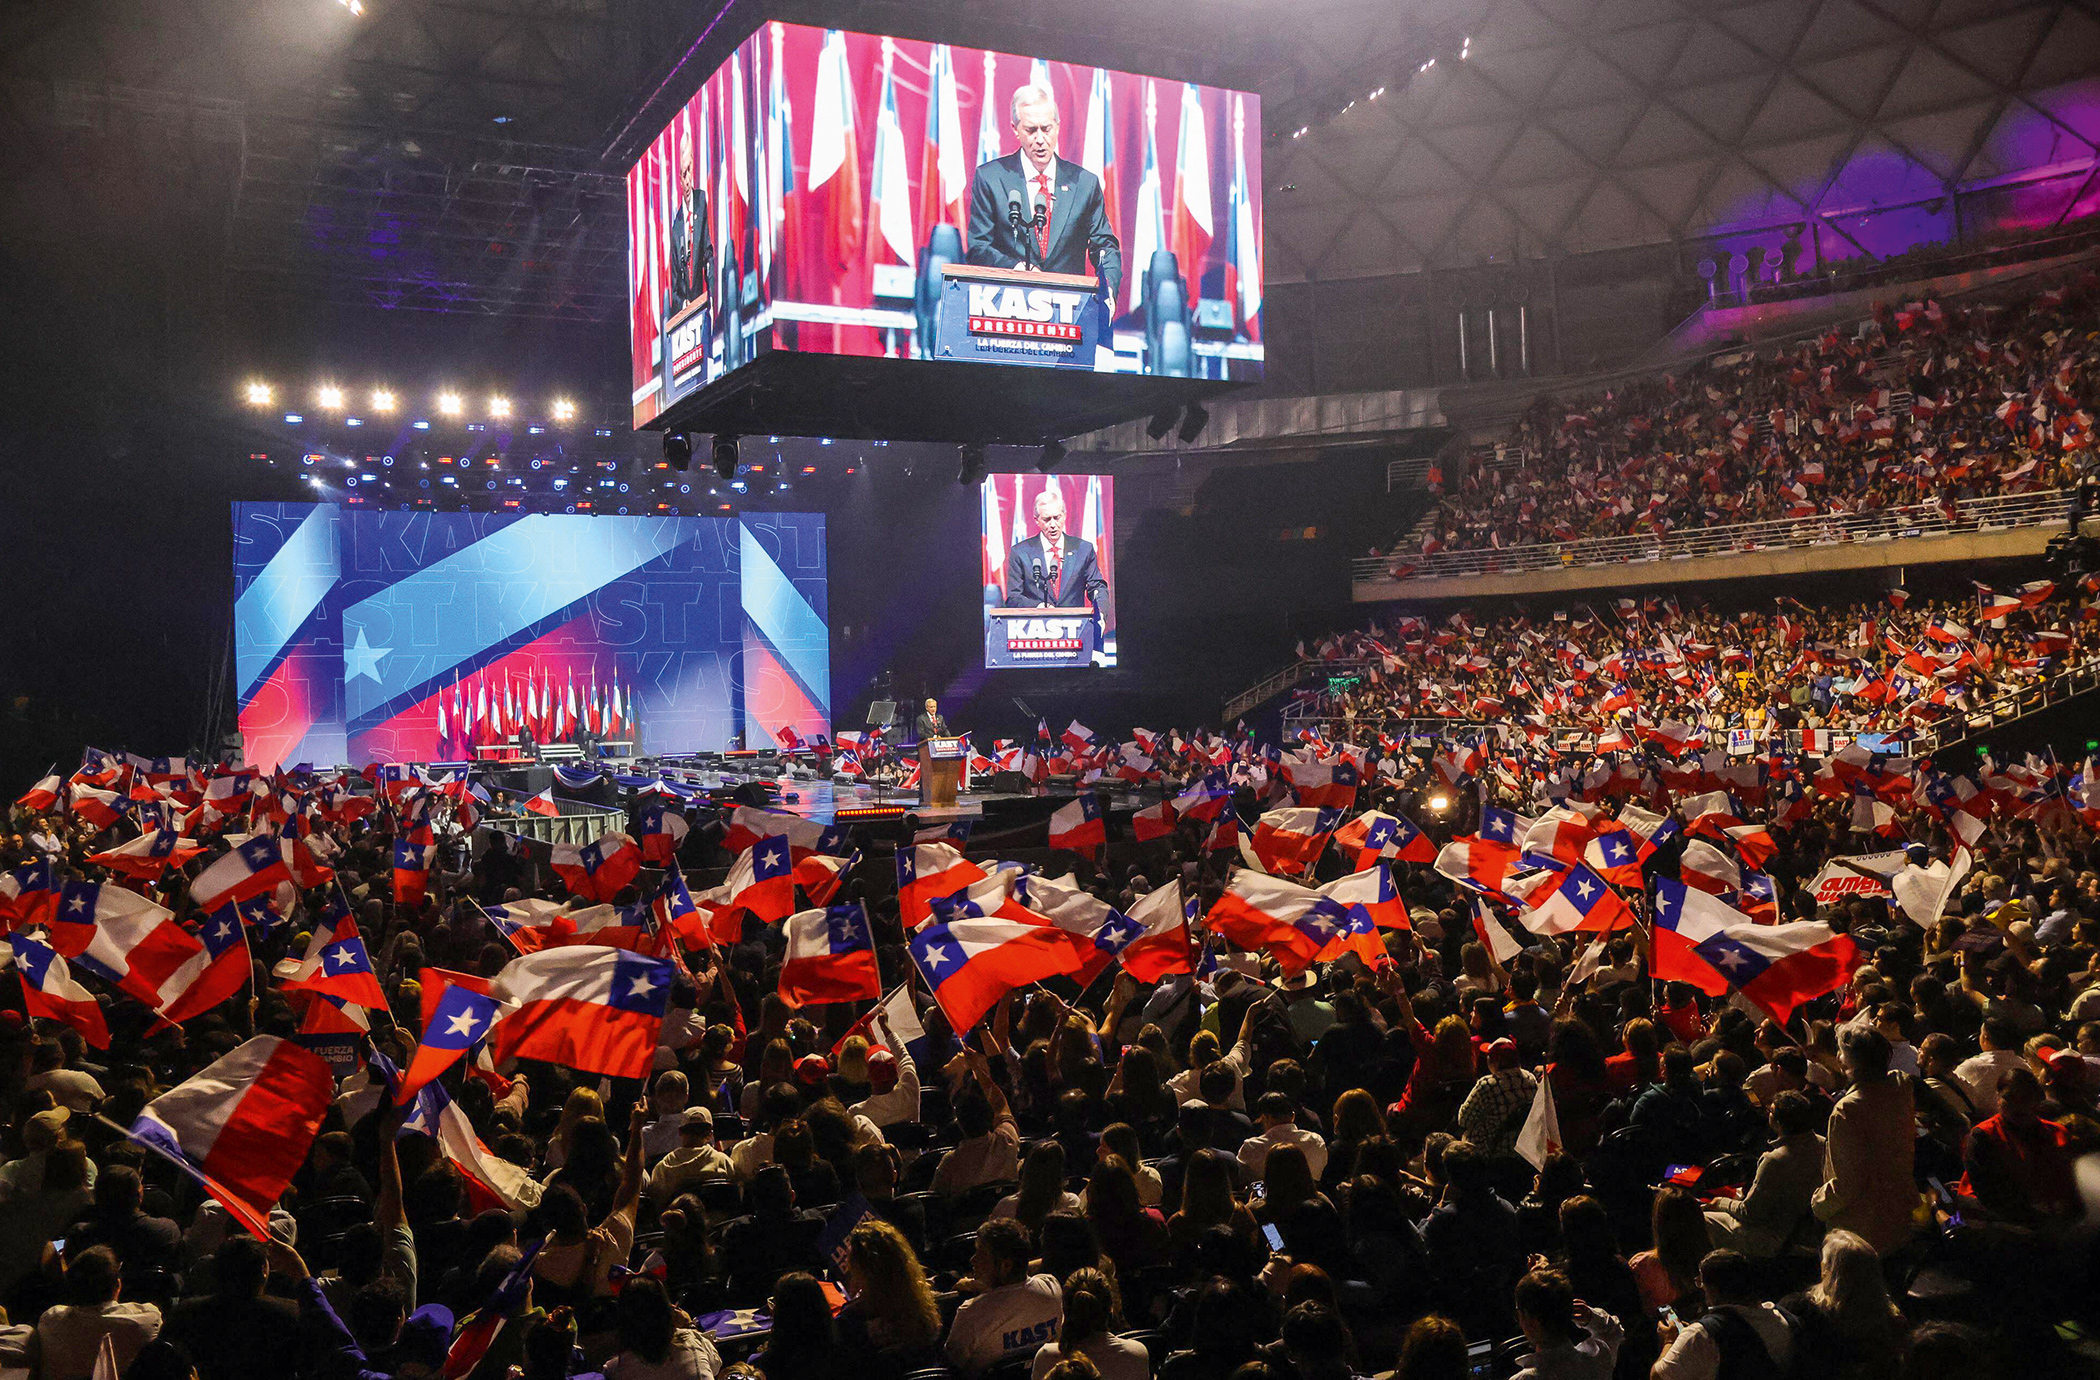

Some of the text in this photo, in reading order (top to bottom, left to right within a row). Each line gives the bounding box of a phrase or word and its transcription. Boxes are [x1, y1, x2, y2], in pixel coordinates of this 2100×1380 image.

[969, 284, 1081, 324] KAST
[972, 319, 1077, 338] PRESIDENTE
[672, 314, 703, 362] KAST
[977, 338, 988, 347] LA
[1024, 341, 1041, 350] DEL
[1007, 619, 1082, 640] KAST
[1010, 640, 1079, 649] PRESIDENTE
[934, 740, 958, 748] KAST
[314, 1046, 354, 1055] FUERZA
[322, 1054, 354, 1063] AMBIO
[1003, 1317, 1058, 1350] KAST
